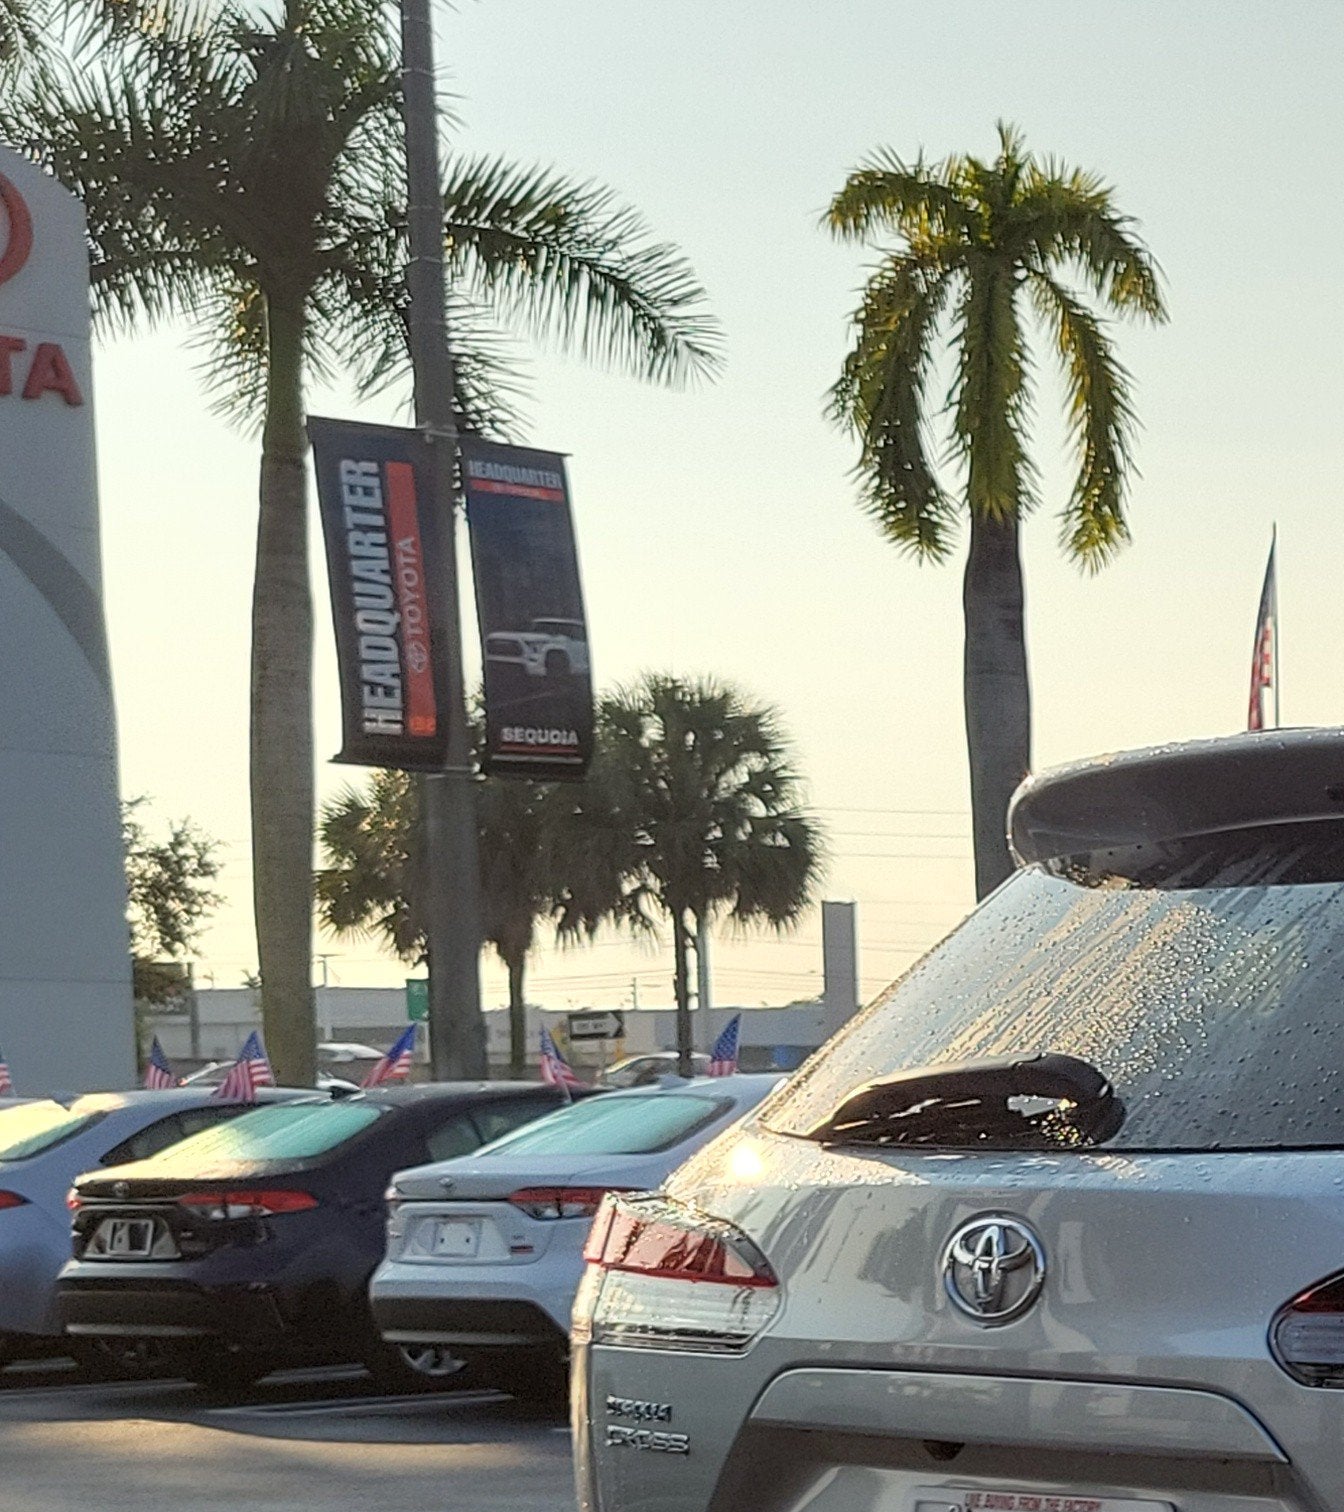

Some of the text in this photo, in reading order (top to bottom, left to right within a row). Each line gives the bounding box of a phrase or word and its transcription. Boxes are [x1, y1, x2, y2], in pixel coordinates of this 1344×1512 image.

[469, 460, 563, 489] HEADQUARTER
[340, 459, 402, 737] HEADQUARTER
[396, 537, 423, 636] TOYOTA
[502, 727, 578, 746] SEQUOIA
[1045, 1498, 1061, 1512] THE
